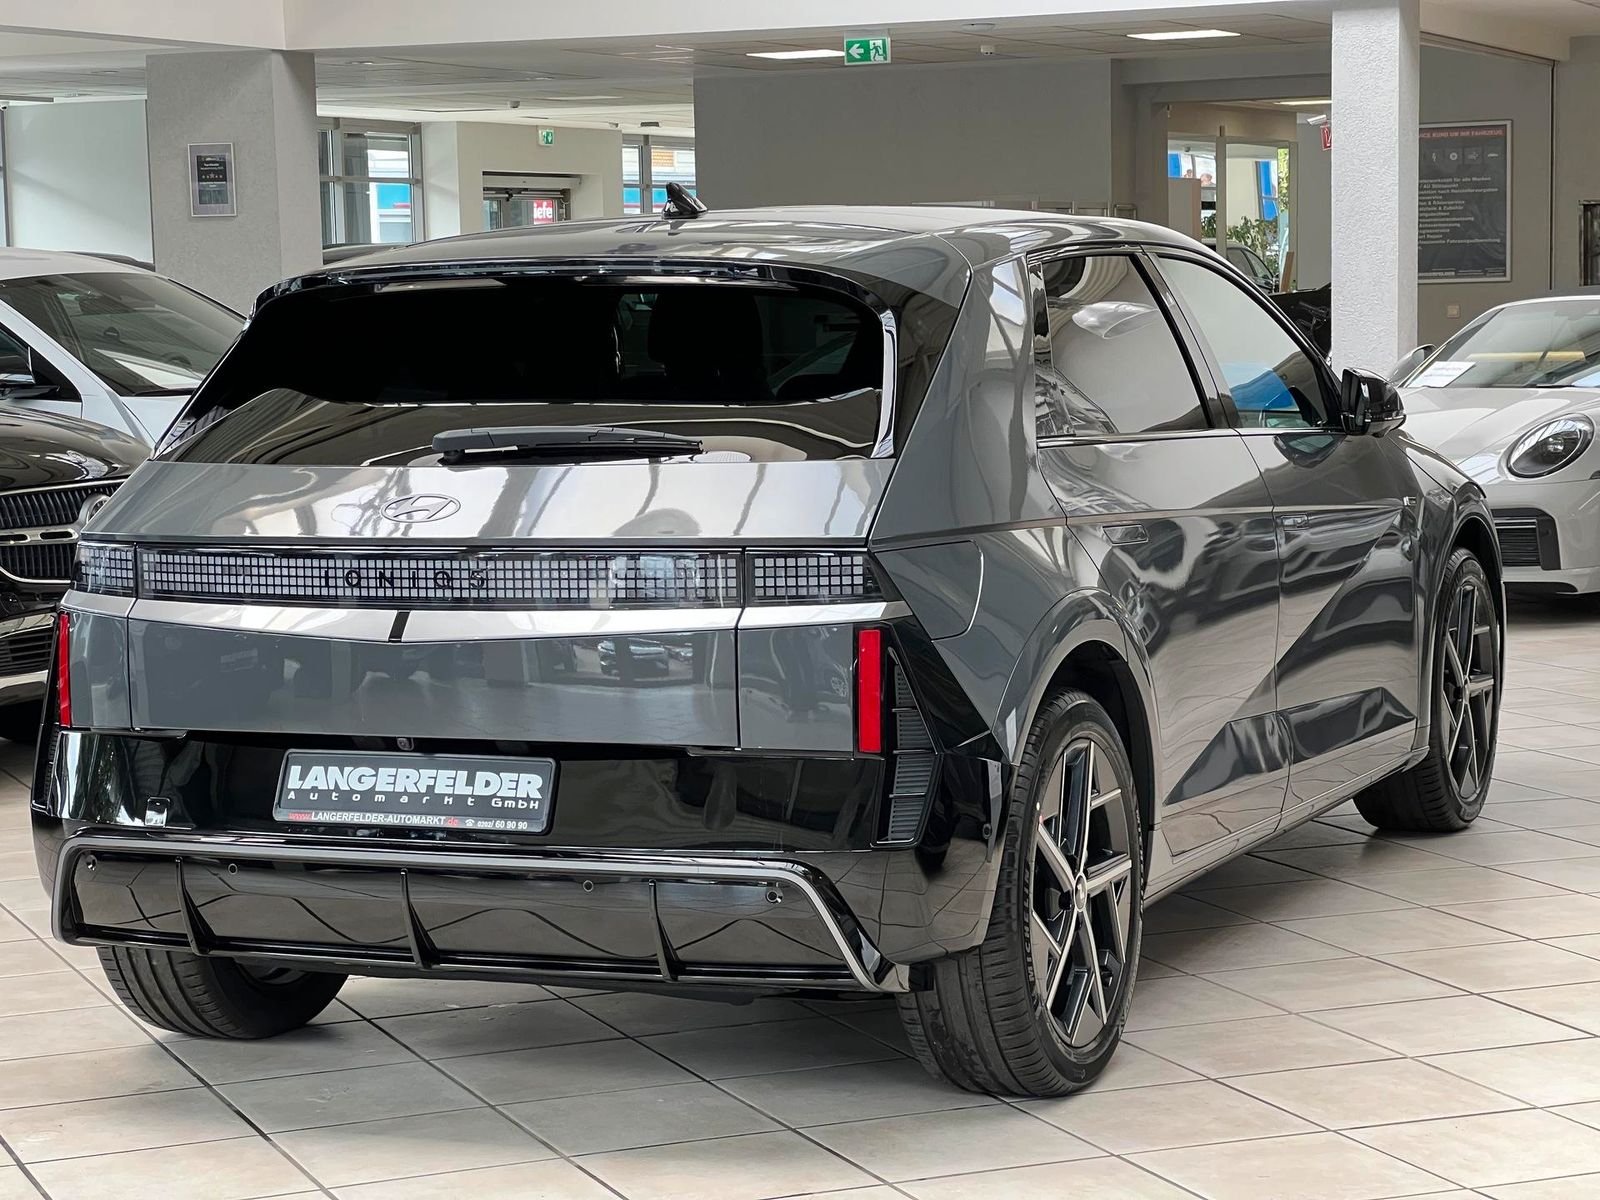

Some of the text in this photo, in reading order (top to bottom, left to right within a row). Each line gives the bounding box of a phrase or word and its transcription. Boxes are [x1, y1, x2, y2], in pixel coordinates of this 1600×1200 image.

[287, 765, 543, 799] LANGERFELDER
[491, 798, 539, 810] GmbH
[495, 820, 505, 829] 60
[506, 820, 516, 830] 90
[517, 821, 528, 830] 90
[1023, 867, 1036, 983] MICHELIN
